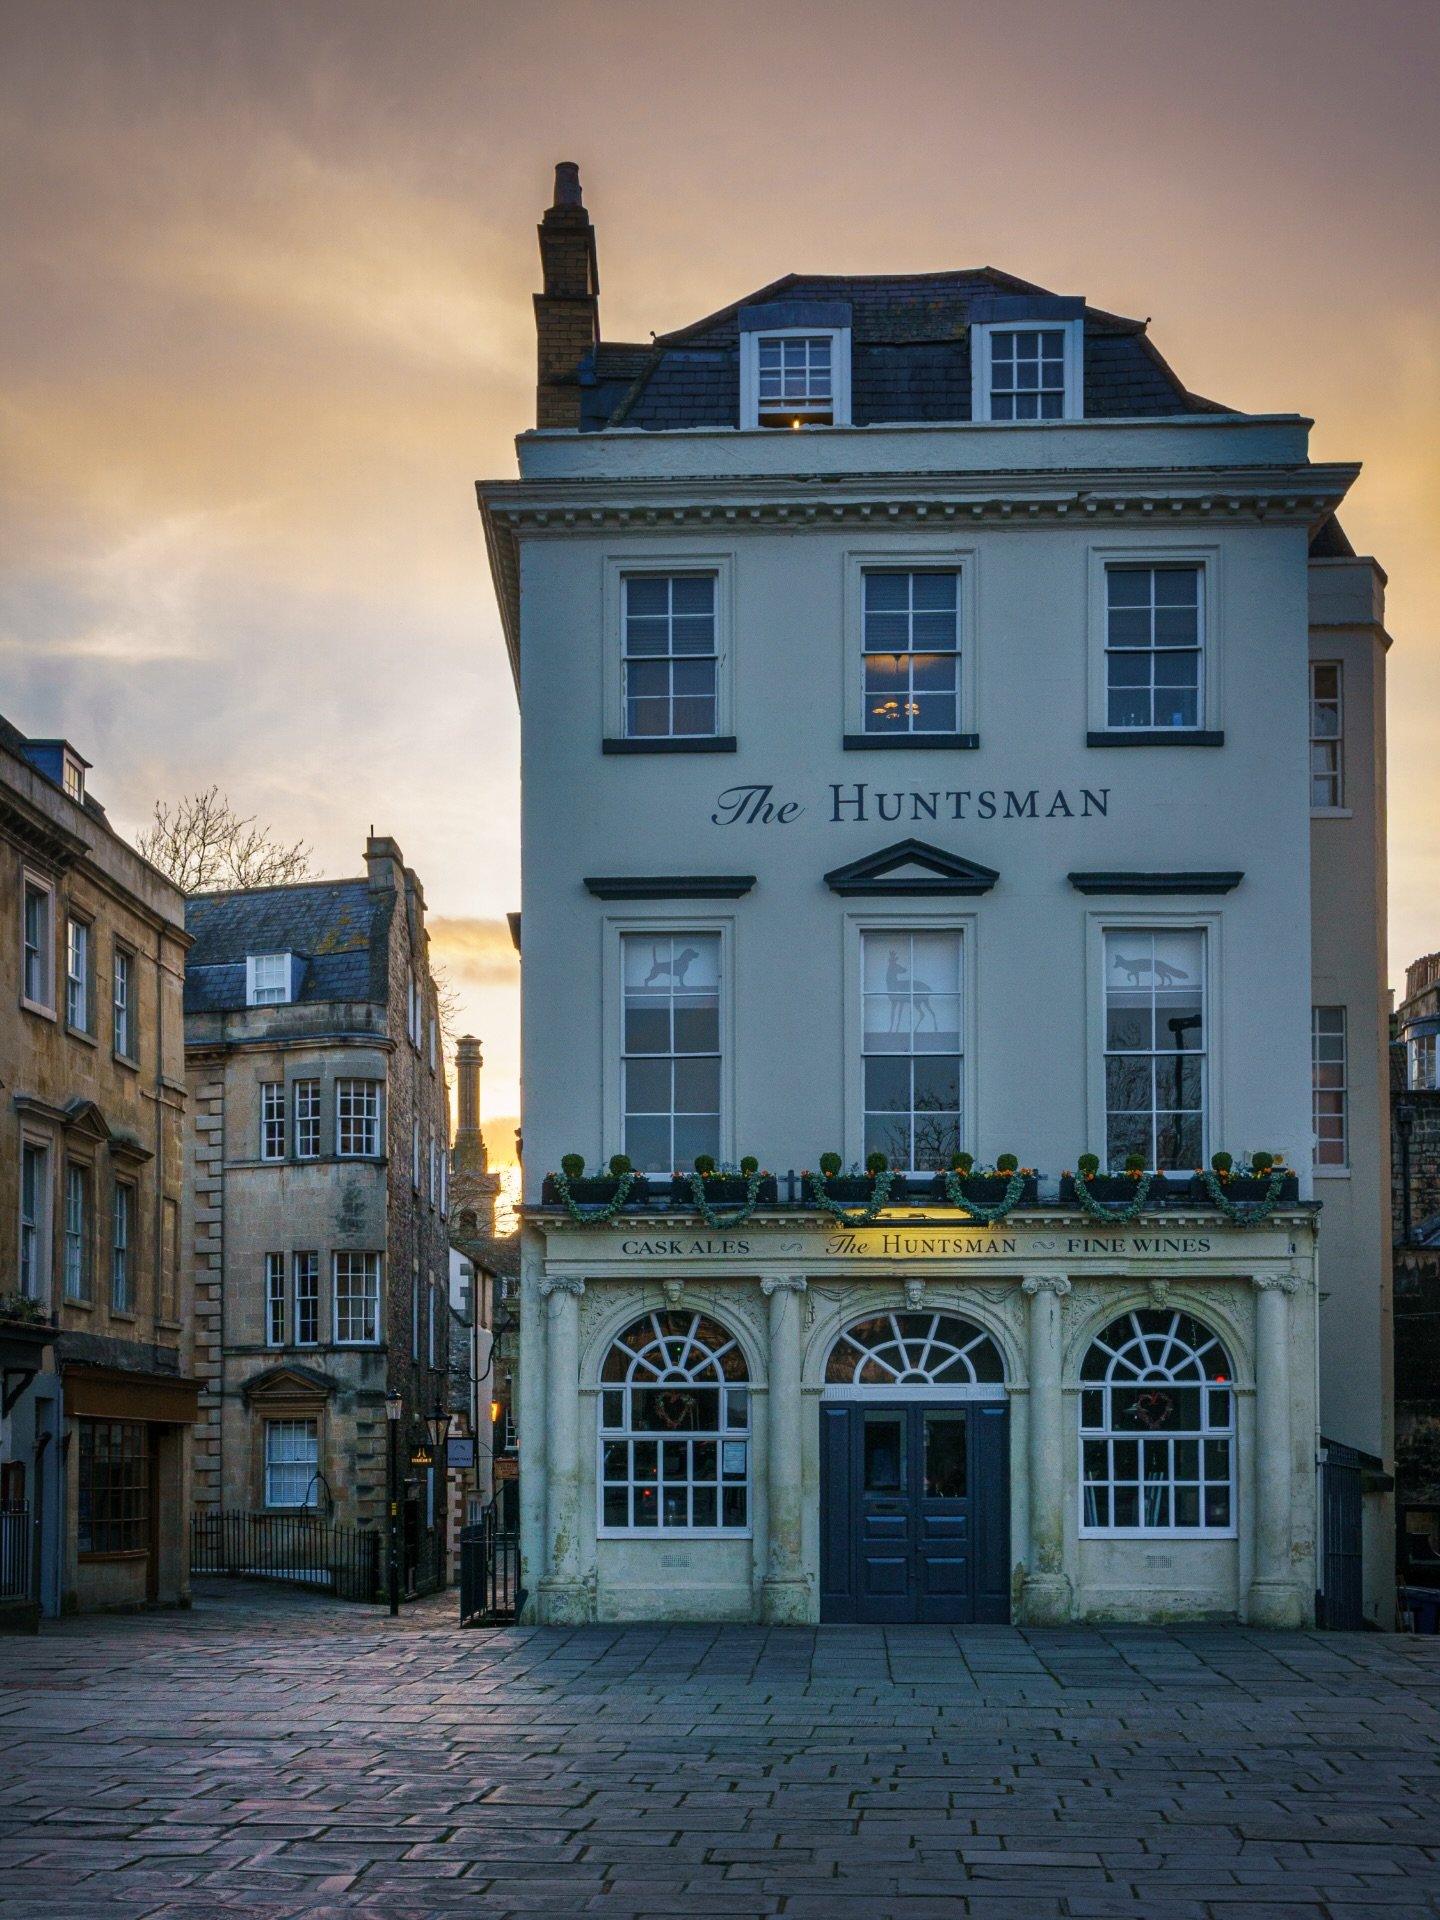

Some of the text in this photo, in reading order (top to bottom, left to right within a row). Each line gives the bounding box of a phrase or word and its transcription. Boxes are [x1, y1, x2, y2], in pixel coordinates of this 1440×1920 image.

[711, 783, 1111, 826] The HUNTSMAN
[622, 1240, 750, 1255] CASK ALES
[826, 1234, 1017, 1255] The HUNTSMAN
[1068, 1238, 1211, 1253] FINE WINES
